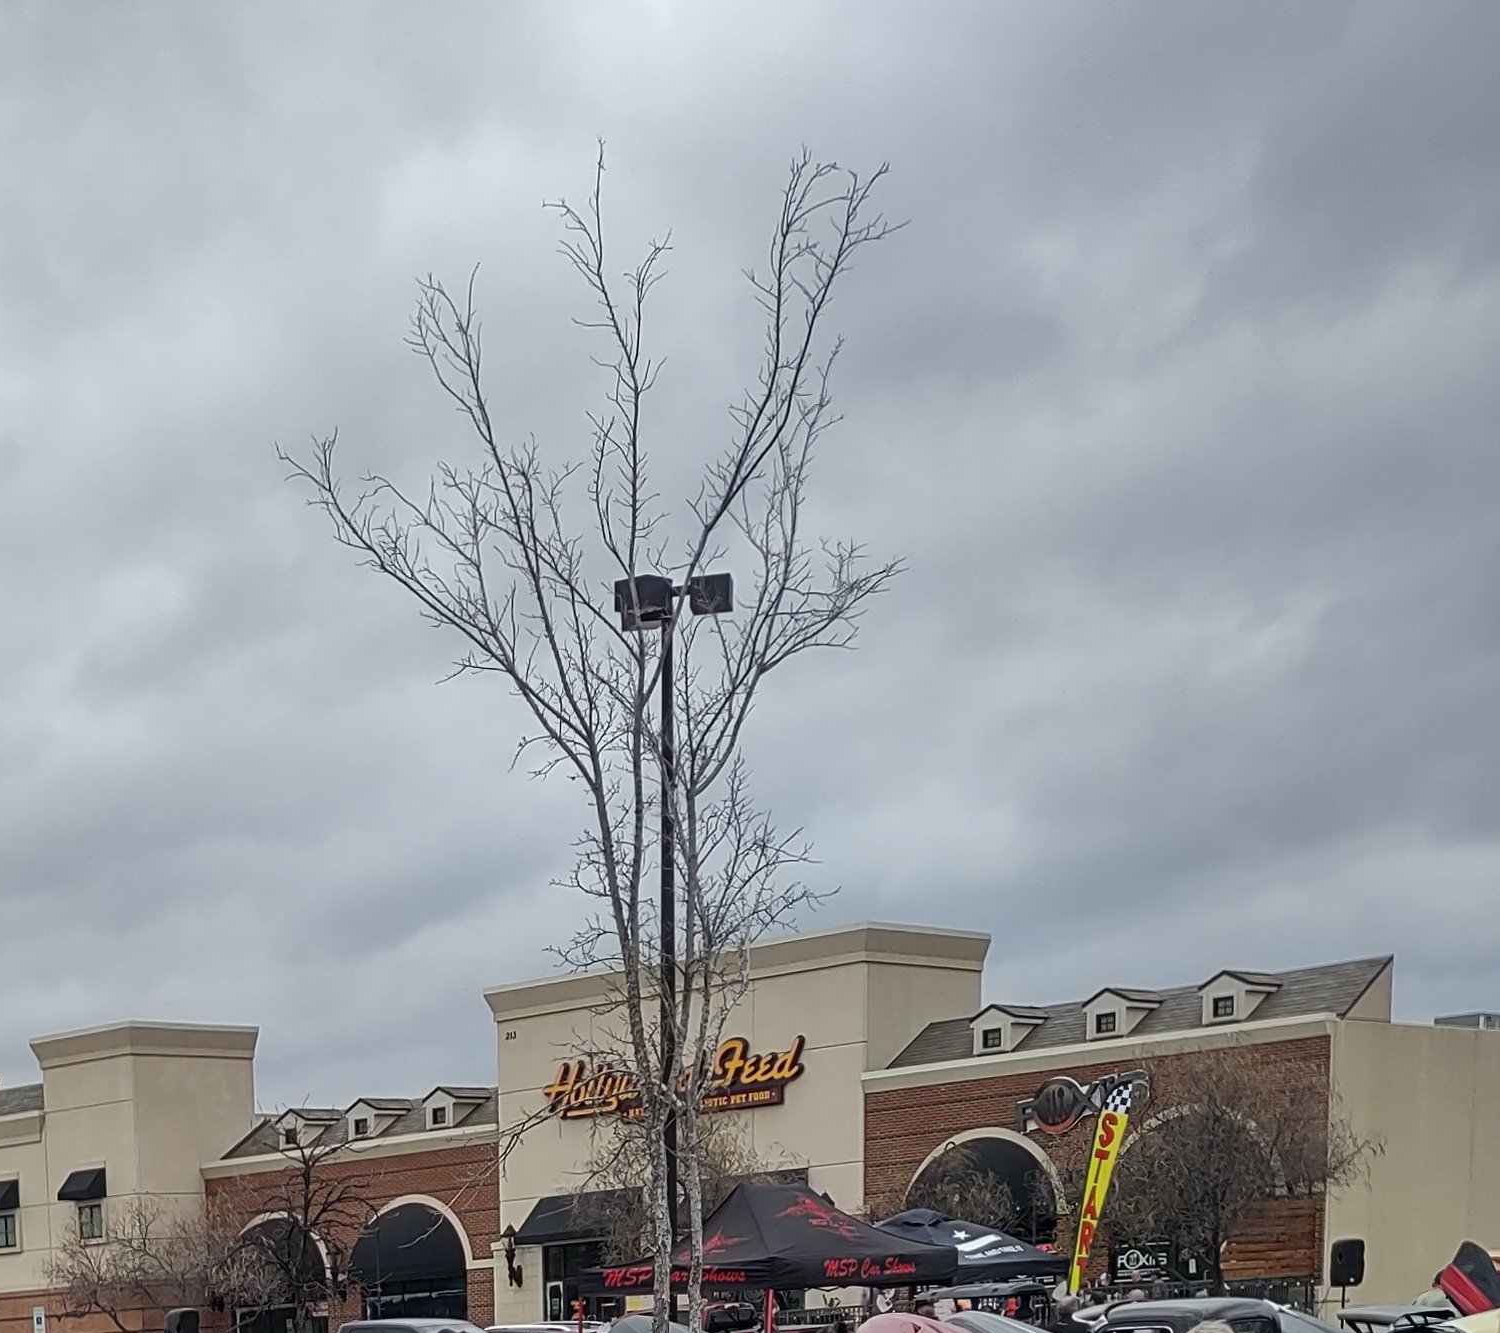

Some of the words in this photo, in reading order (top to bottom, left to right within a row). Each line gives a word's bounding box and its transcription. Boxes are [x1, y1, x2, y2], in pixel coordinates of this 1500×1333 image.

[714, 1036, 804, 1090] Feed
[730, 1092, 747, 1105] PET
[748, 1090, 770, 1102] FOOD
[1076, 1112, 1118, 1273] START
[603, 1265, 653, 1288] MSP
[824, 1258, 858, 1278] MSP
[861, 1258, 880, 1279] Car
[884, 1257, 916, 1276] Shows
